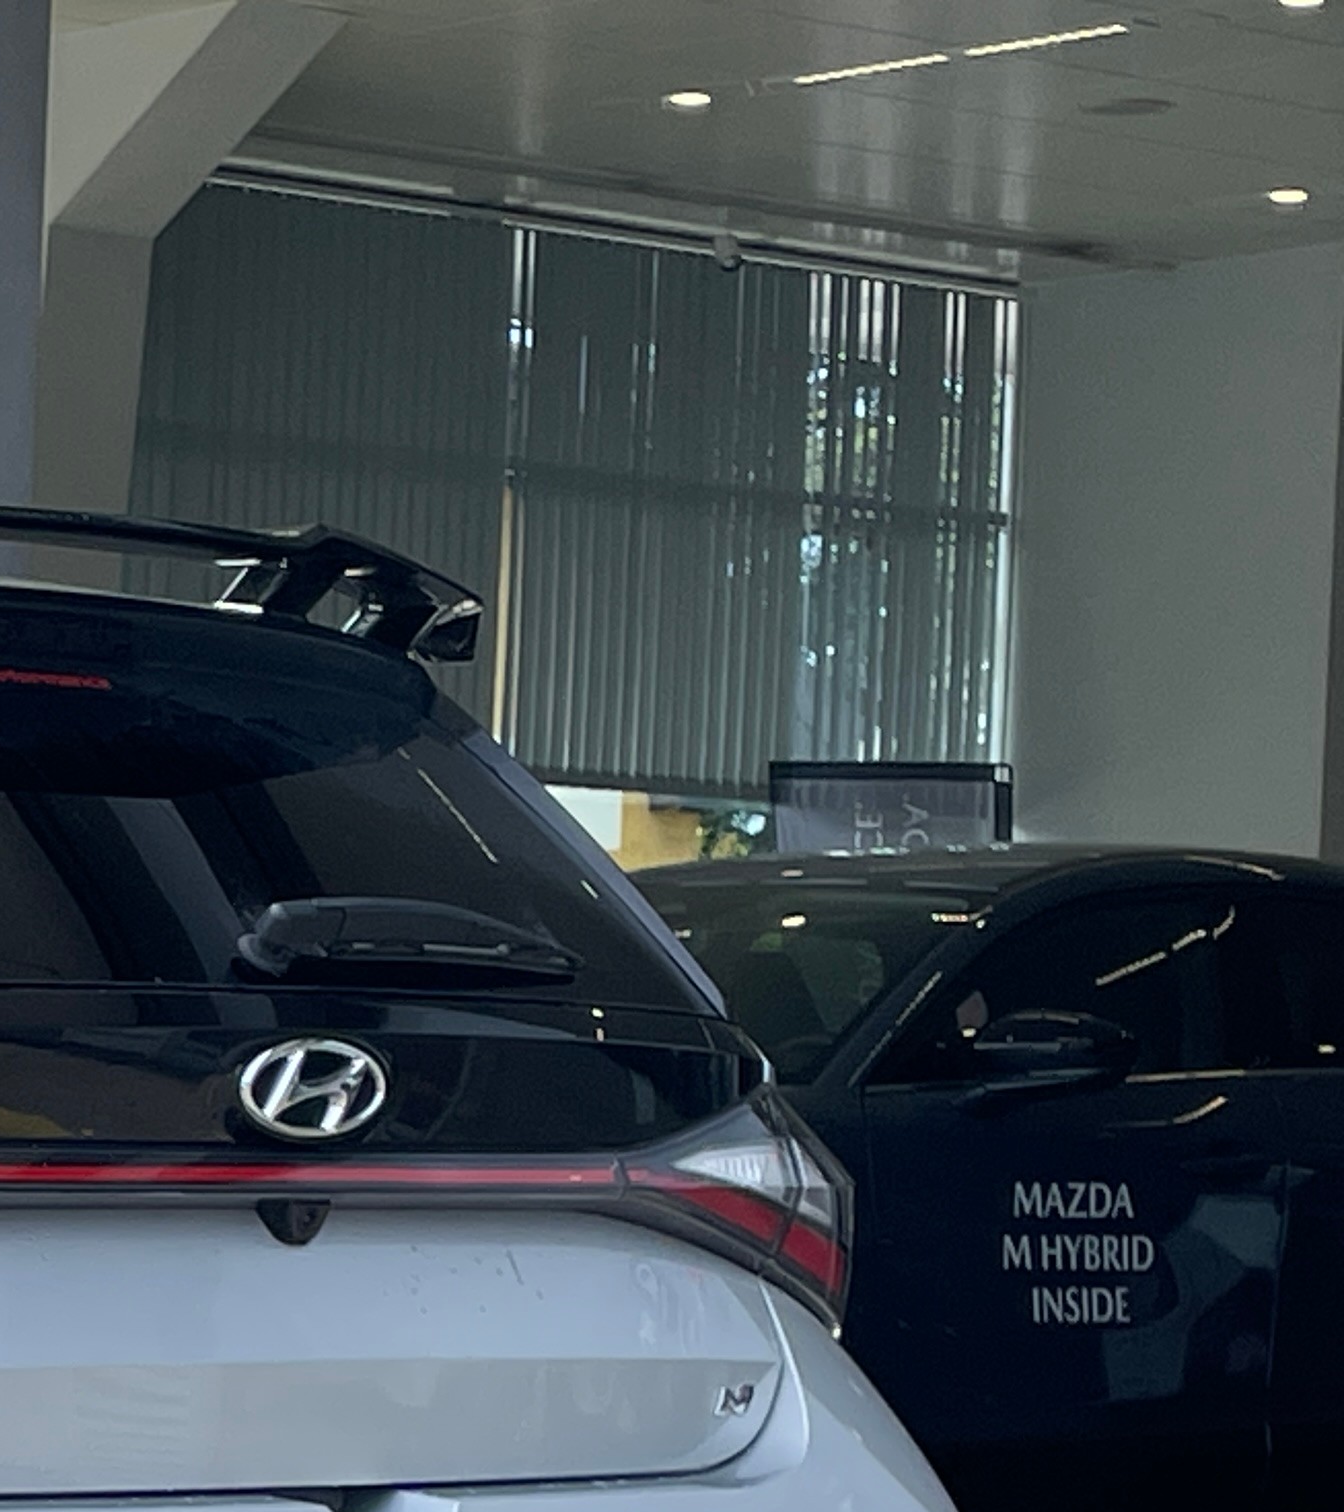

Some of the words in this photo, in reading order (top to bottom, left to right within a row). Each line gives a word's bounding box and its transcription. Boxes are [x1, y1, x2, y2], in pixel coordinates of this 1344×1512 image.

[1013, 1180, 1135, 1219] MAZDA
[1002, 1233, 1033, 1271] M
[1040, 1233, 1156, 1272] HYBRID
[1031, 1286, 1132, 1324] INSIDE
